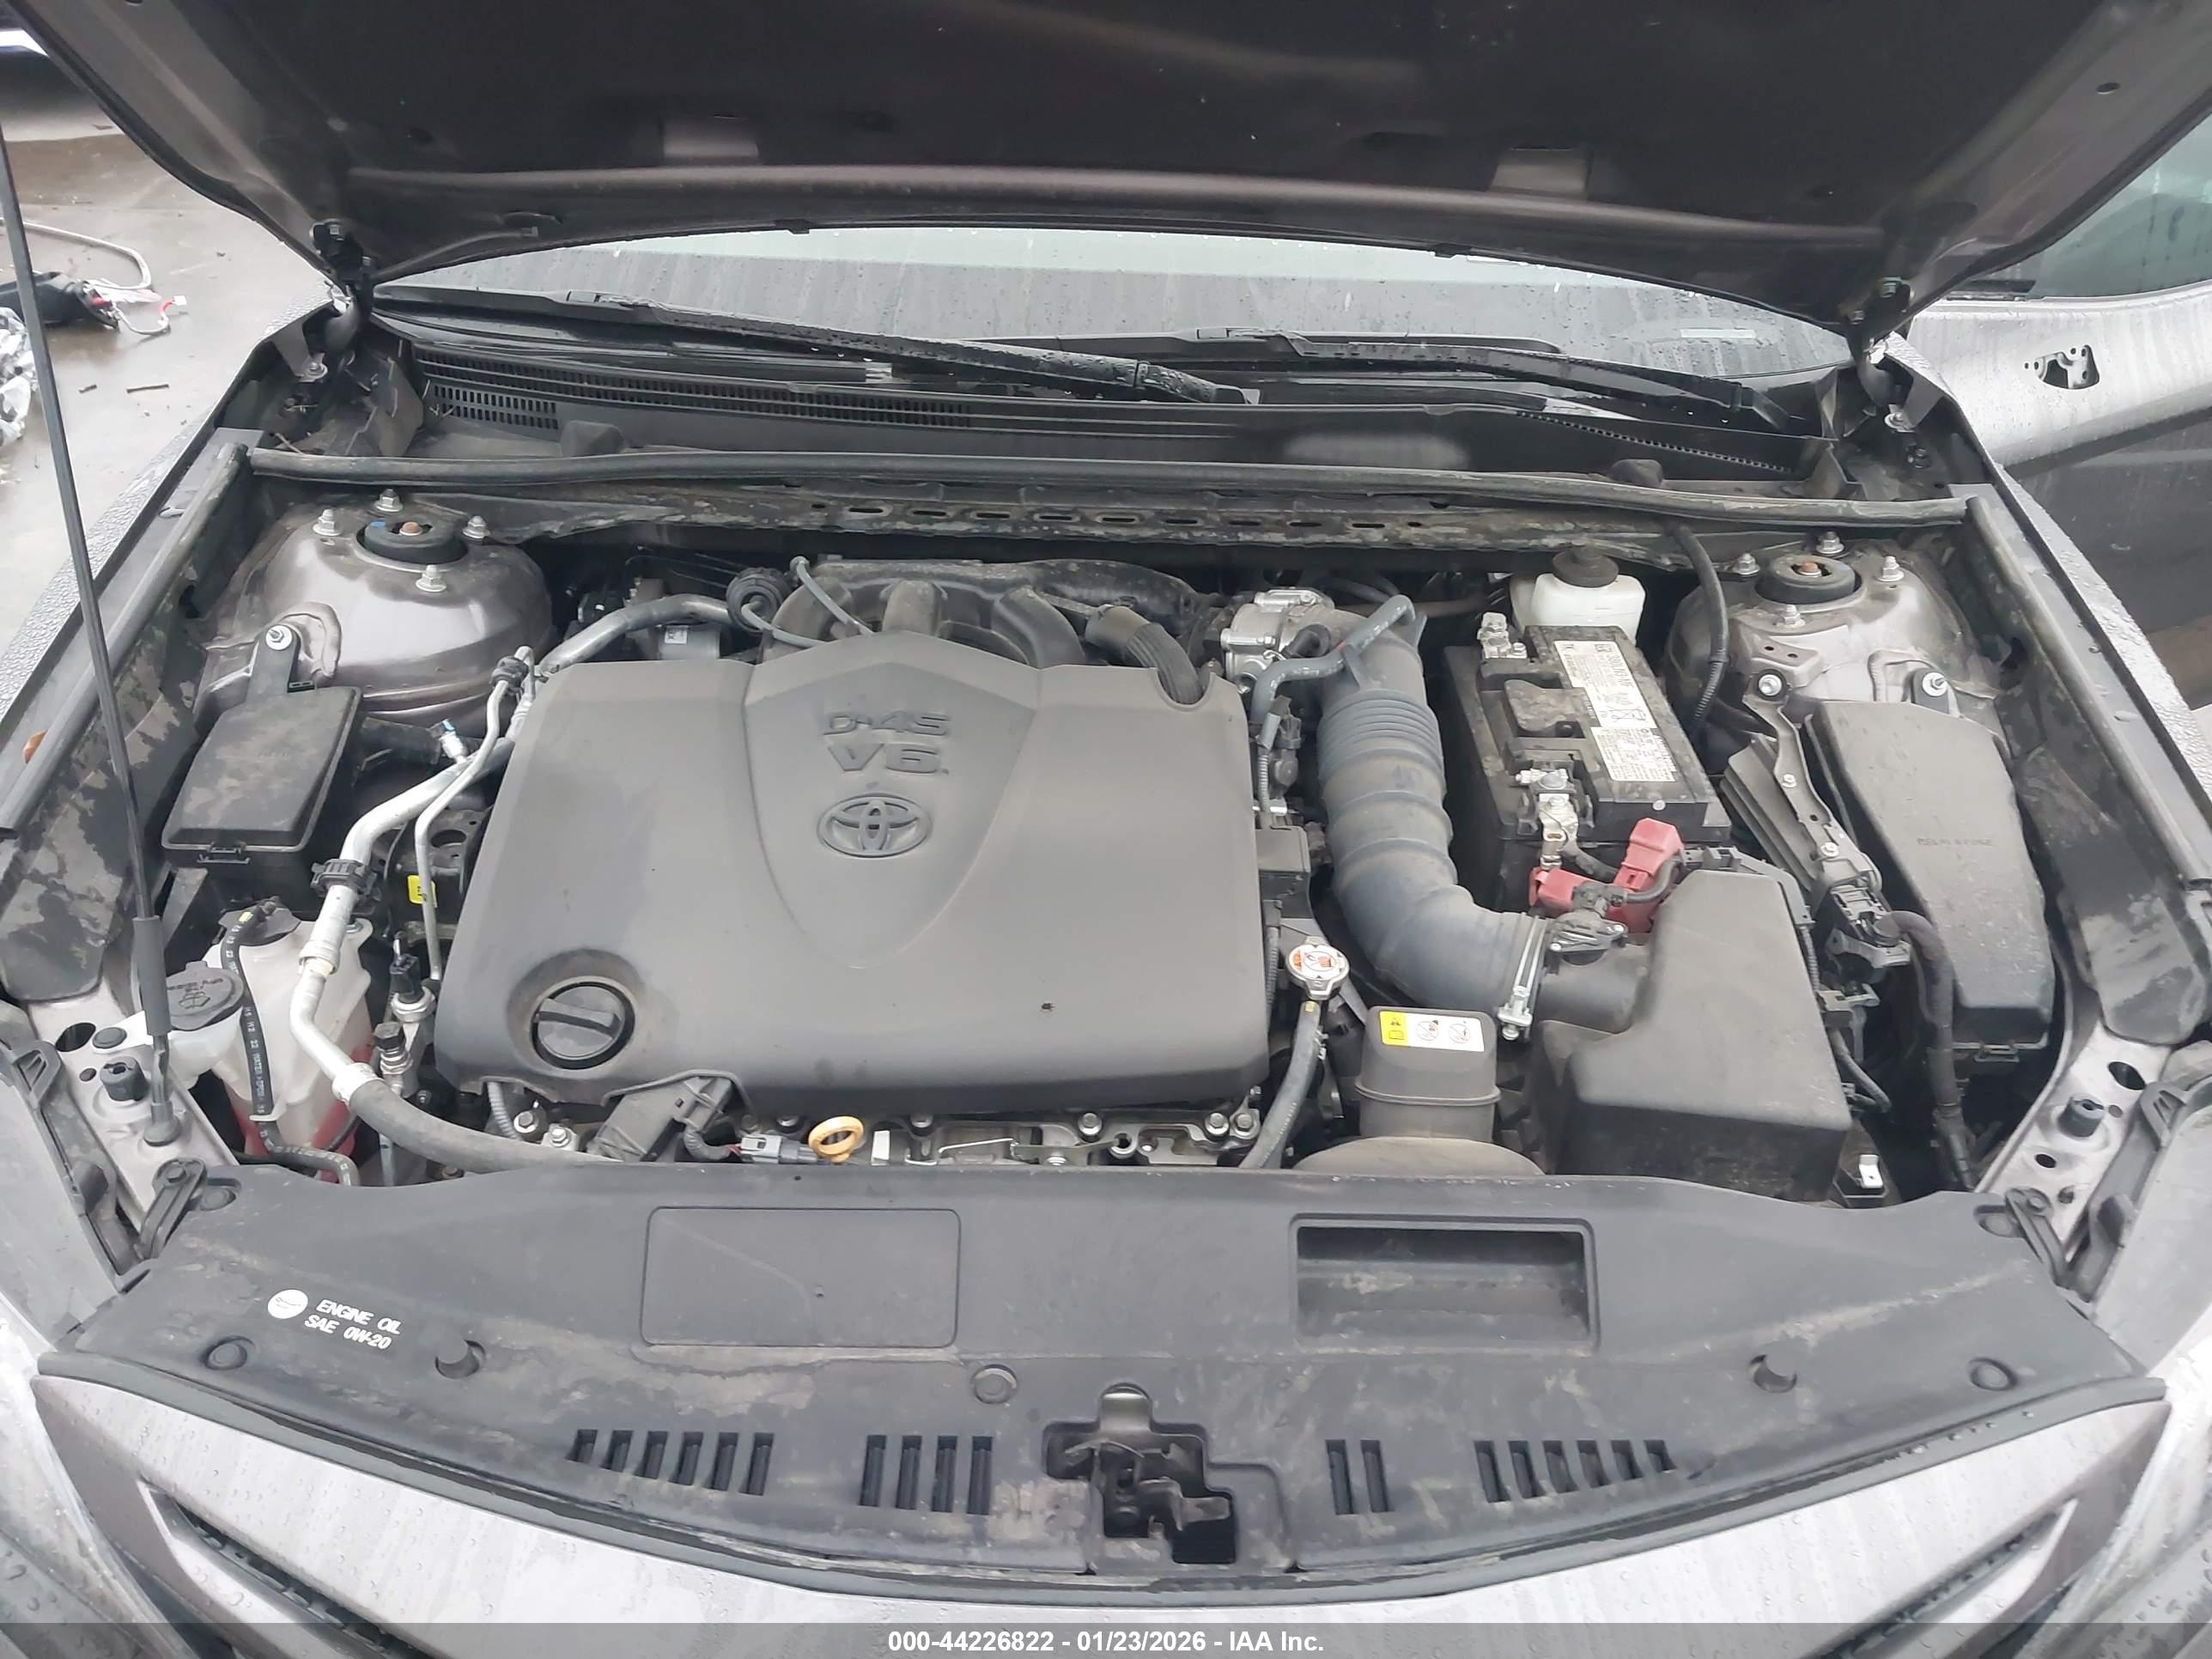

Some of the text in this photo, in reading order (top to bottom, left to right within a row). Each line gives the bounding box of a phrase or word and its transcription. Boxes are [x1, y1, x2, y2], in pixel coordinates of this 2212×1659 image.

[826, 742, 941, 775] V6
[304, 1314, 392, 1349] SAE 0W-20
[316, 1299, 401, 1334] ENGINE OIL
